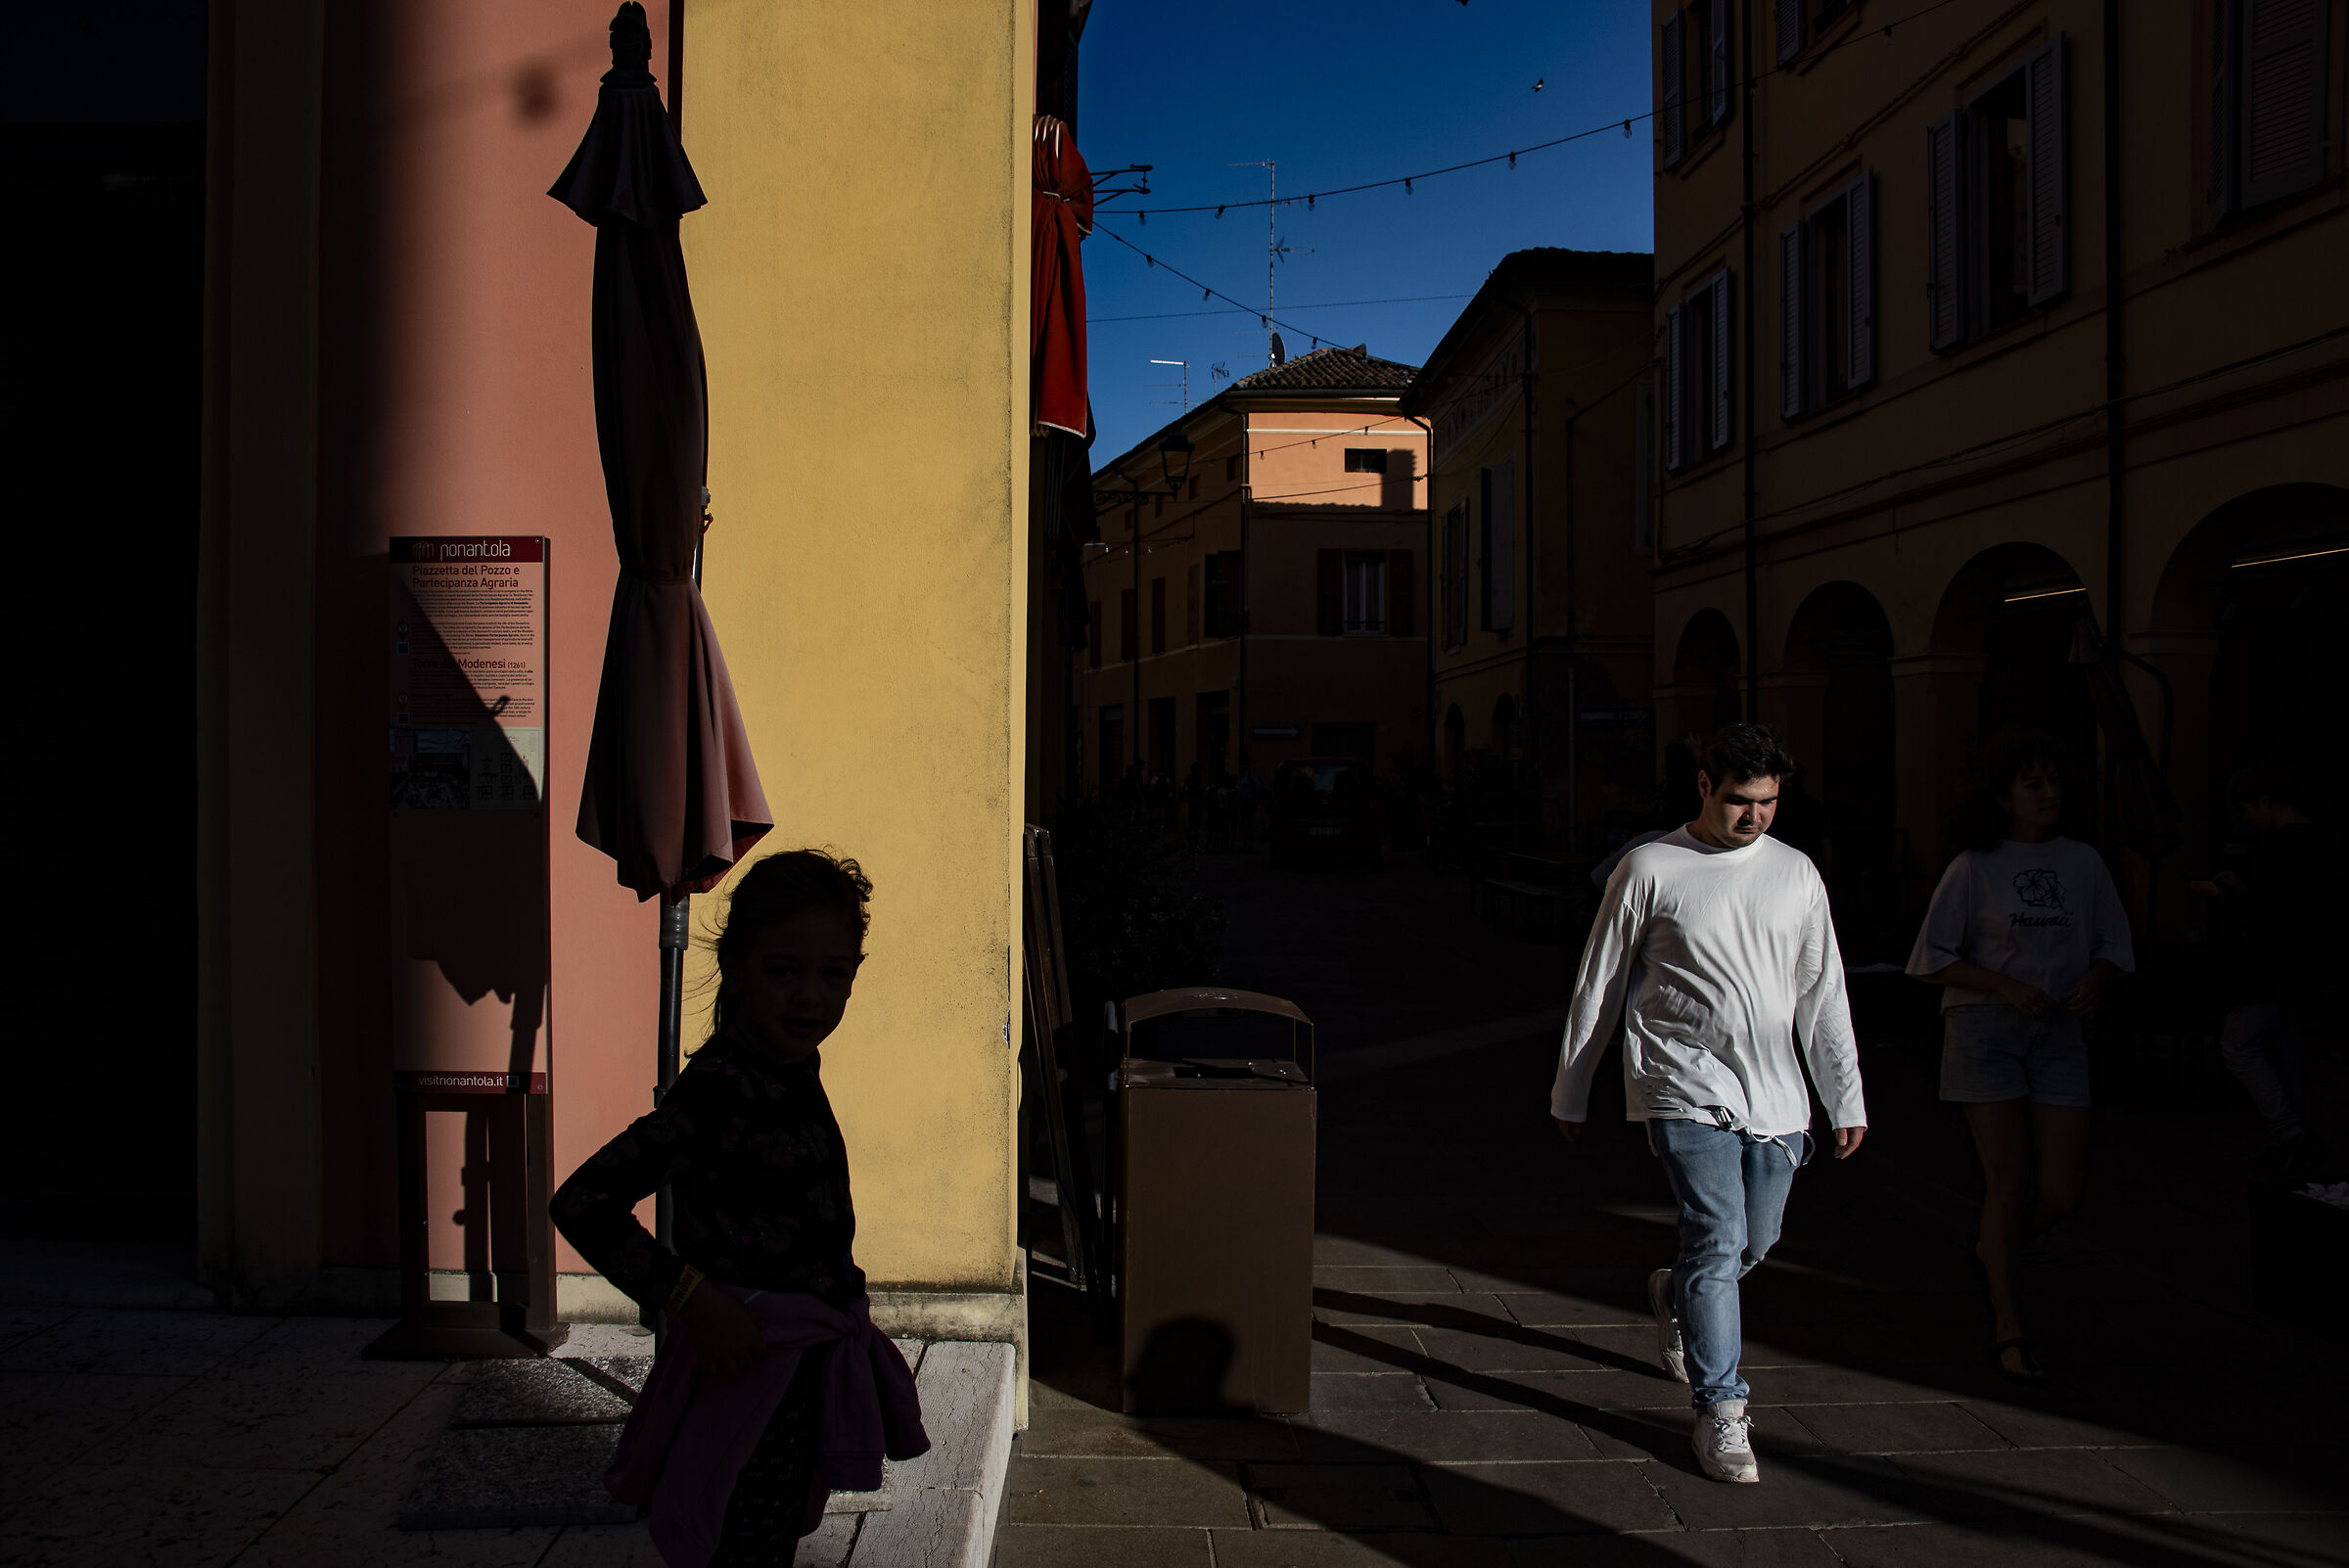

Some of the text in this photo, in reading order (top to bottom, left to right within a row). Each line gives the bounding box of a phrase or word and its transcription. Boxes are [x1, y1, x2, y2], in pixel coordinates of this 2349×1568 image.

[440, 539, 511, 562] nonantola
[413, 565, 520, 576] Piazzetta del Pozzo e
[412, 577, 519, 589] Partecipanza Agraria
[458, 658, 506, 669] Modenesi
[2009, 911, 2074, 927] Hawaii
[418, 1075, 504, 1087] visitnonantola.it
